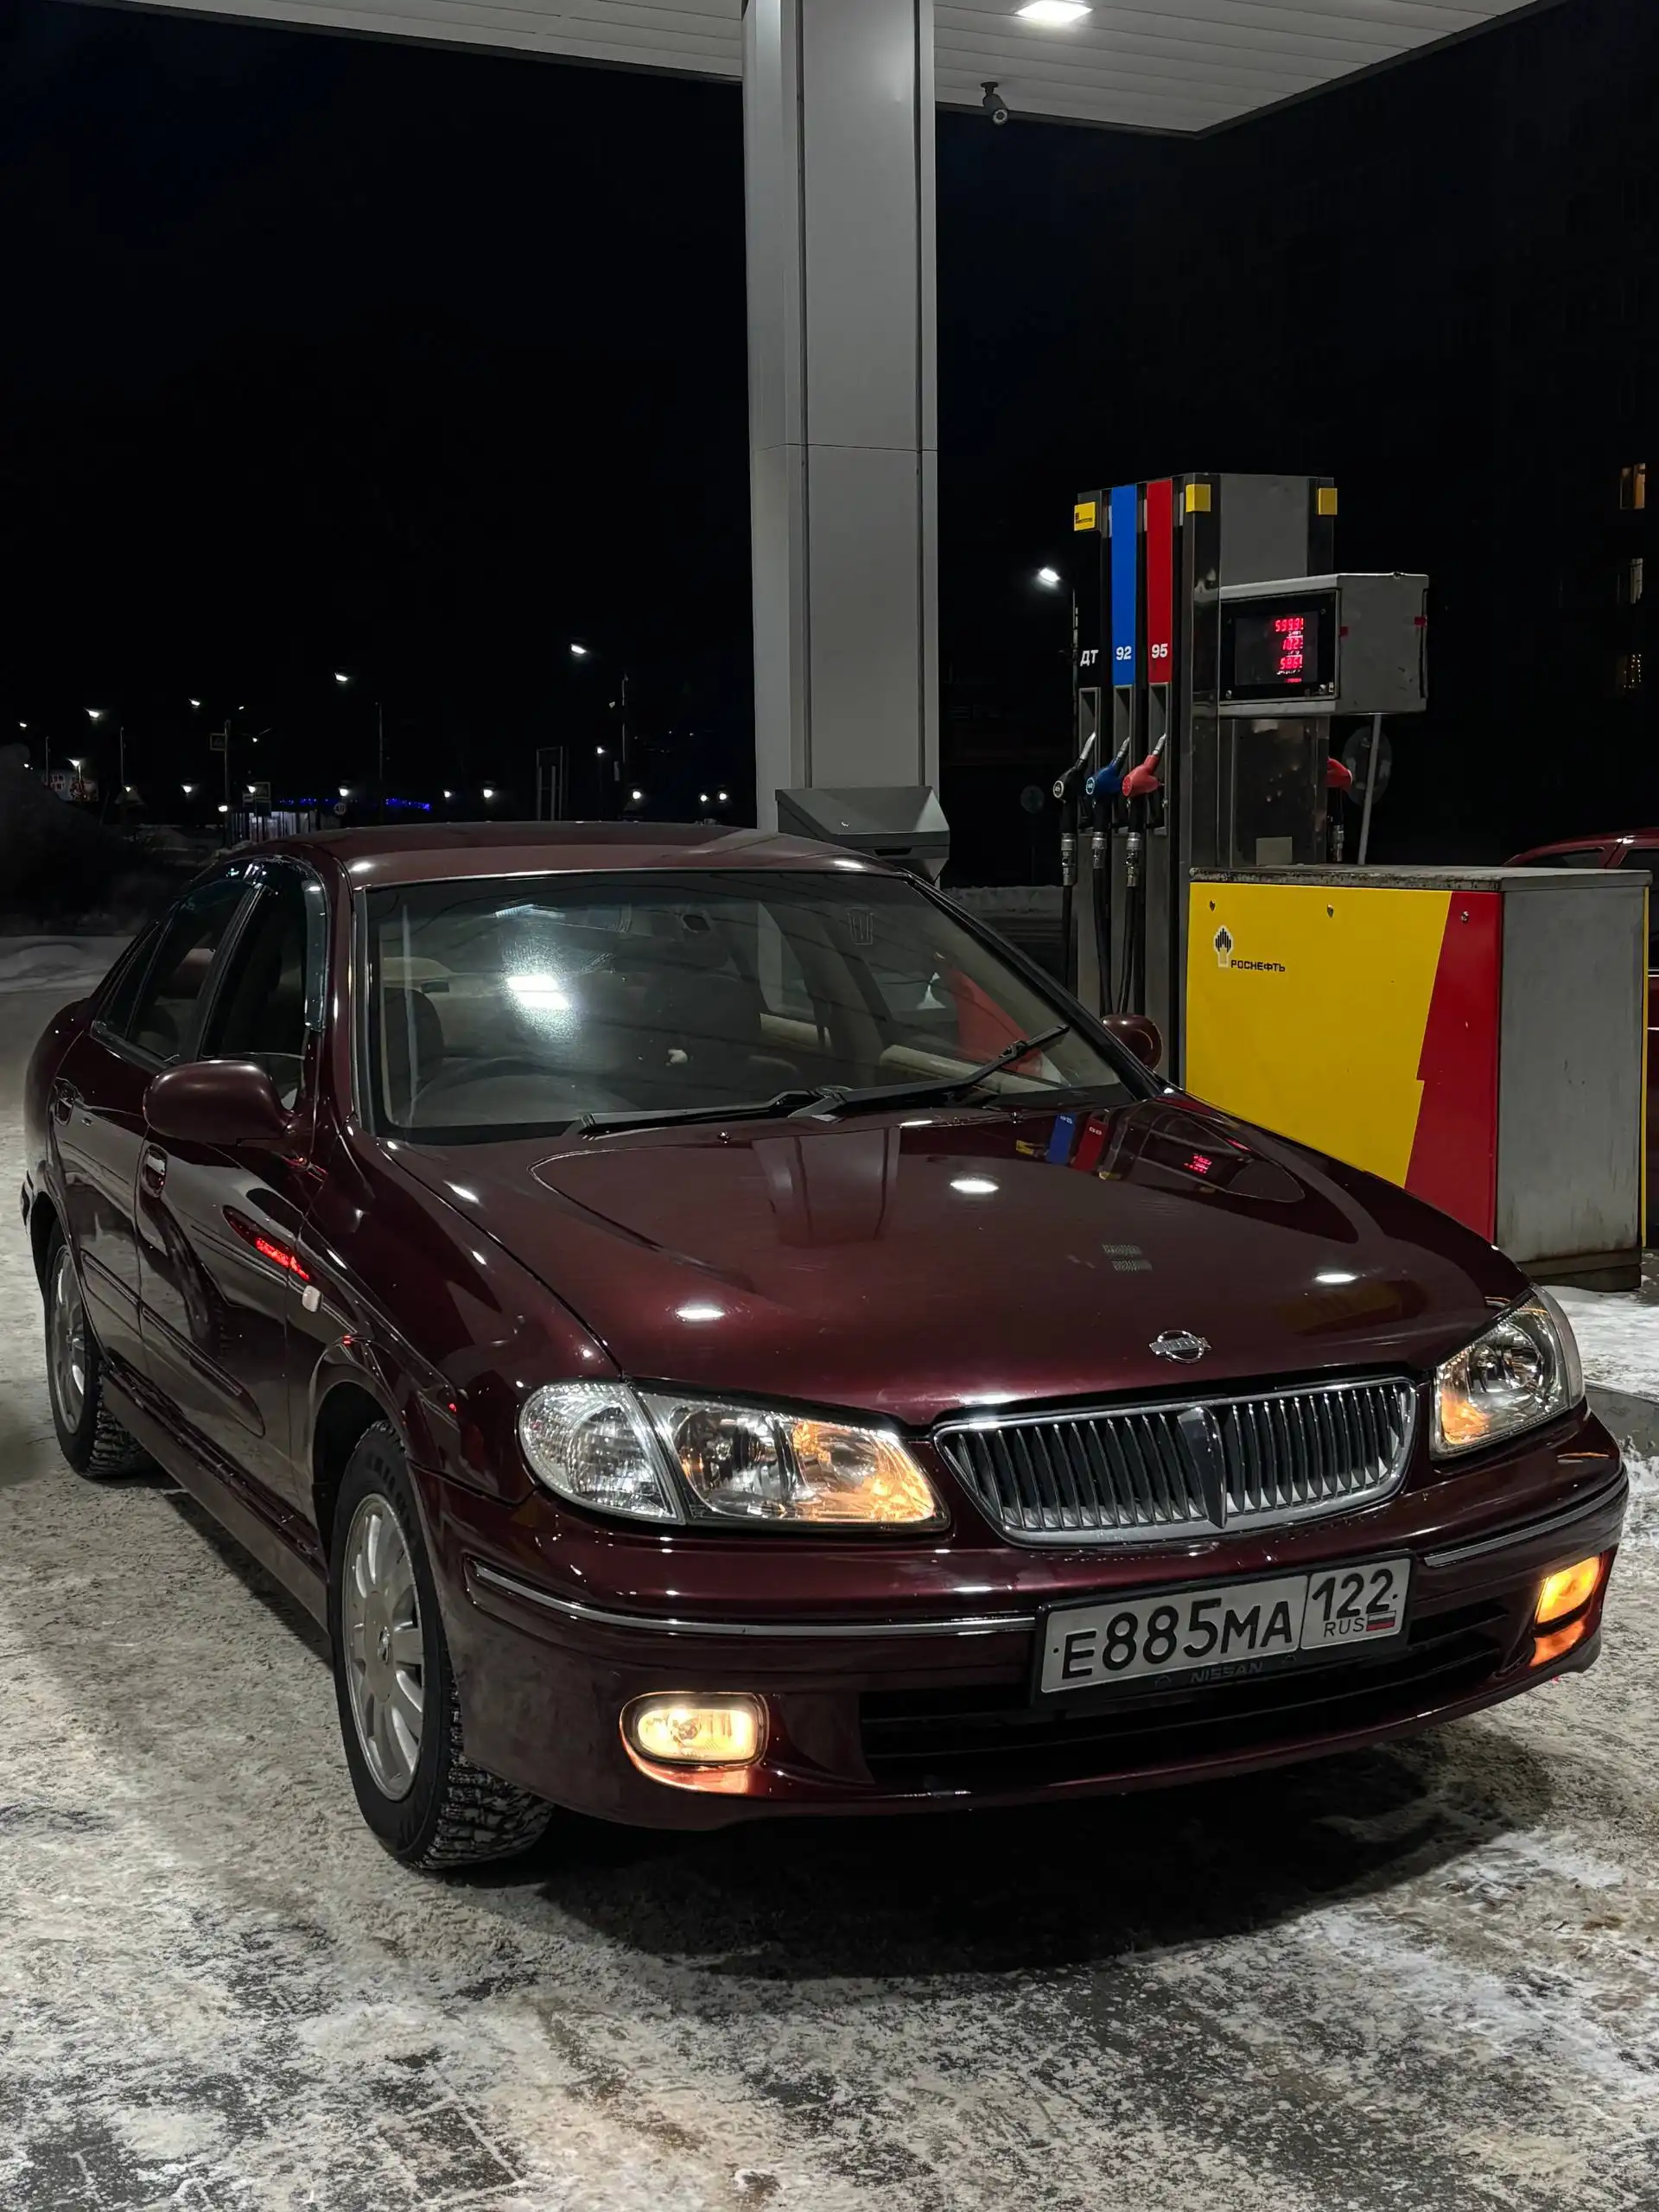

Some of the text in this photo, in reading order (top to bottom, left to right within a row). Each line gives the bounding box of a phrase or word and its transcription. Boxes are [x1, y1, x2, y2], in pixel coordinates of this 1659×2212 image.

[1080, 650, 1099, 667] ДТ
[1116, 646, 1132, 661] 92
[1151, 644, 1168, 658] 95
[1230, 959, 1286, 972] РОСНЕФТЬ
[1312, 1568, 1394, 1621] 122
[1323, 1617, 1365, 1638] RUS
